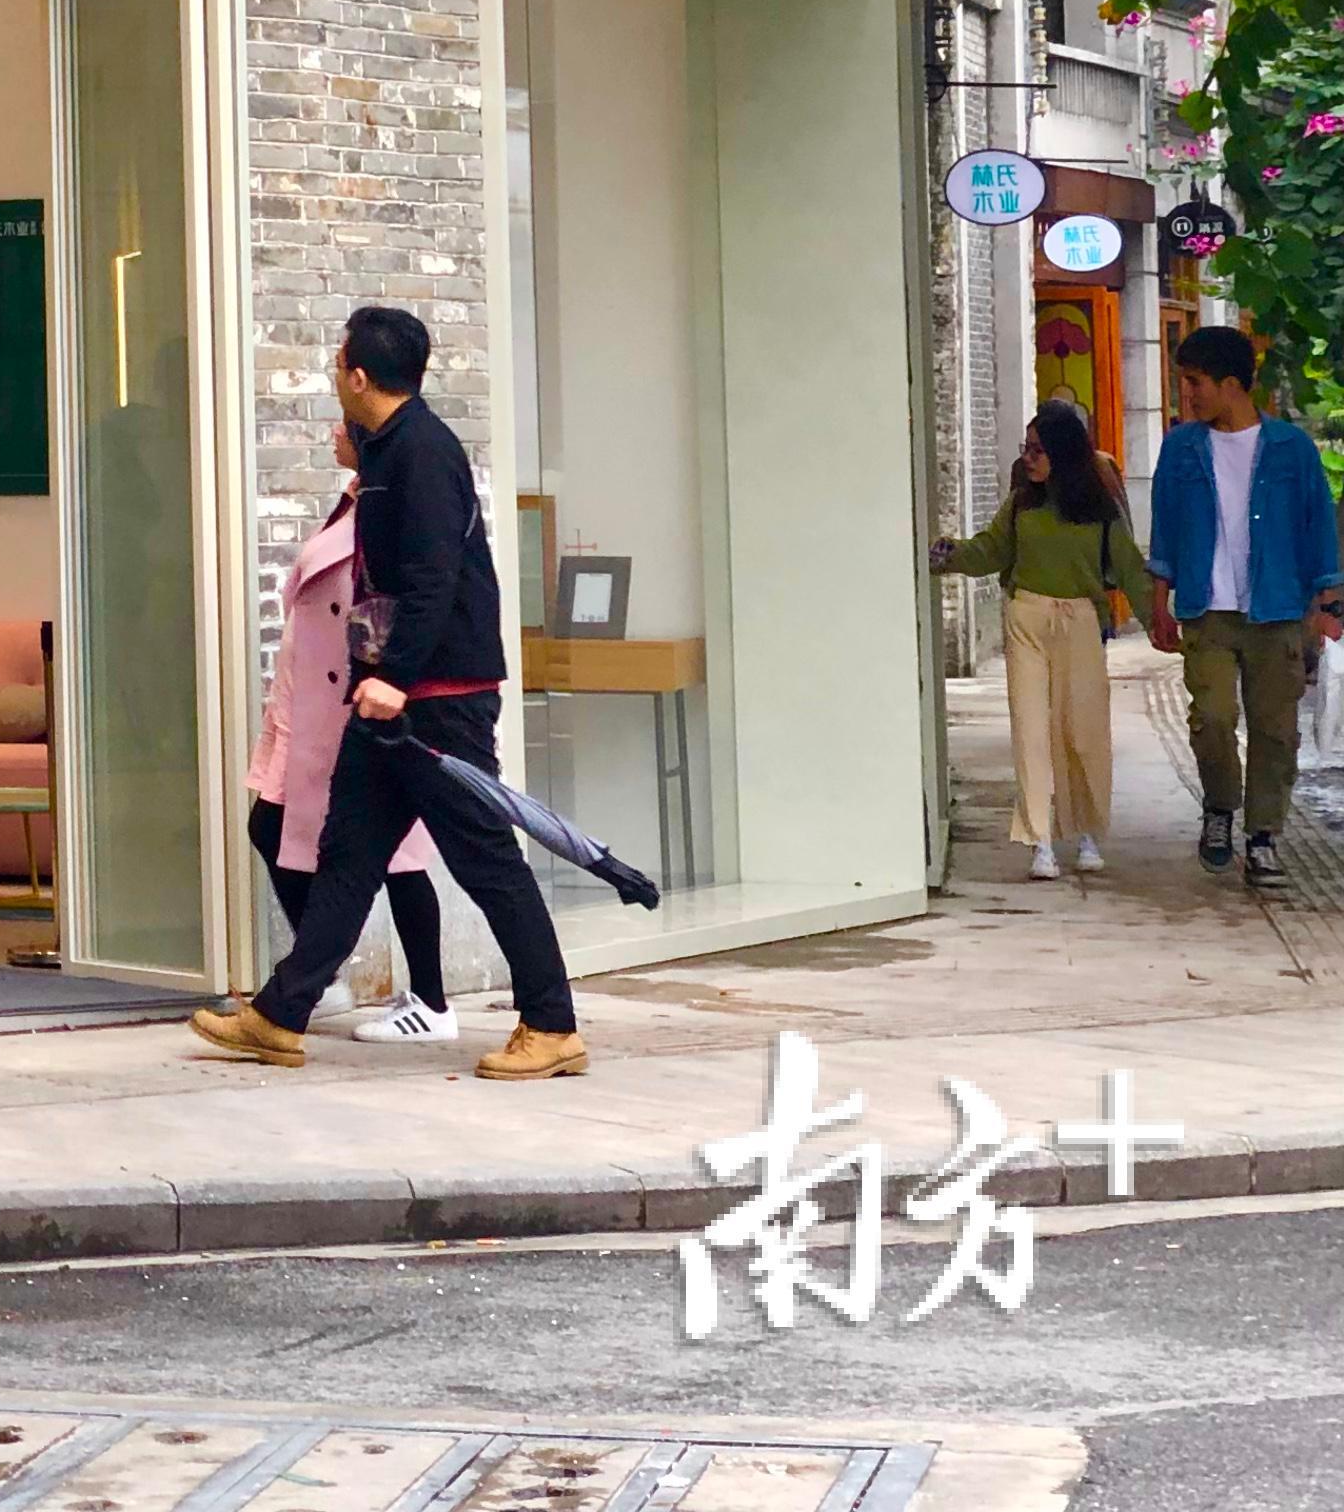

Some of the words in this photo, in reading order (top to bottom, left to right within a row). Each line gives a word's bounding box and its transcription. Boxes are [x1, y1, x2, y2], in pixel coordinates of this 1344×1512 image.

[971, 164, 1018, 187] 林氏
[973, 190, 1021, 214] 木业
[1064, 225, 1100, 243] 林氏
[1066, 246, 1102, 264] 木业
